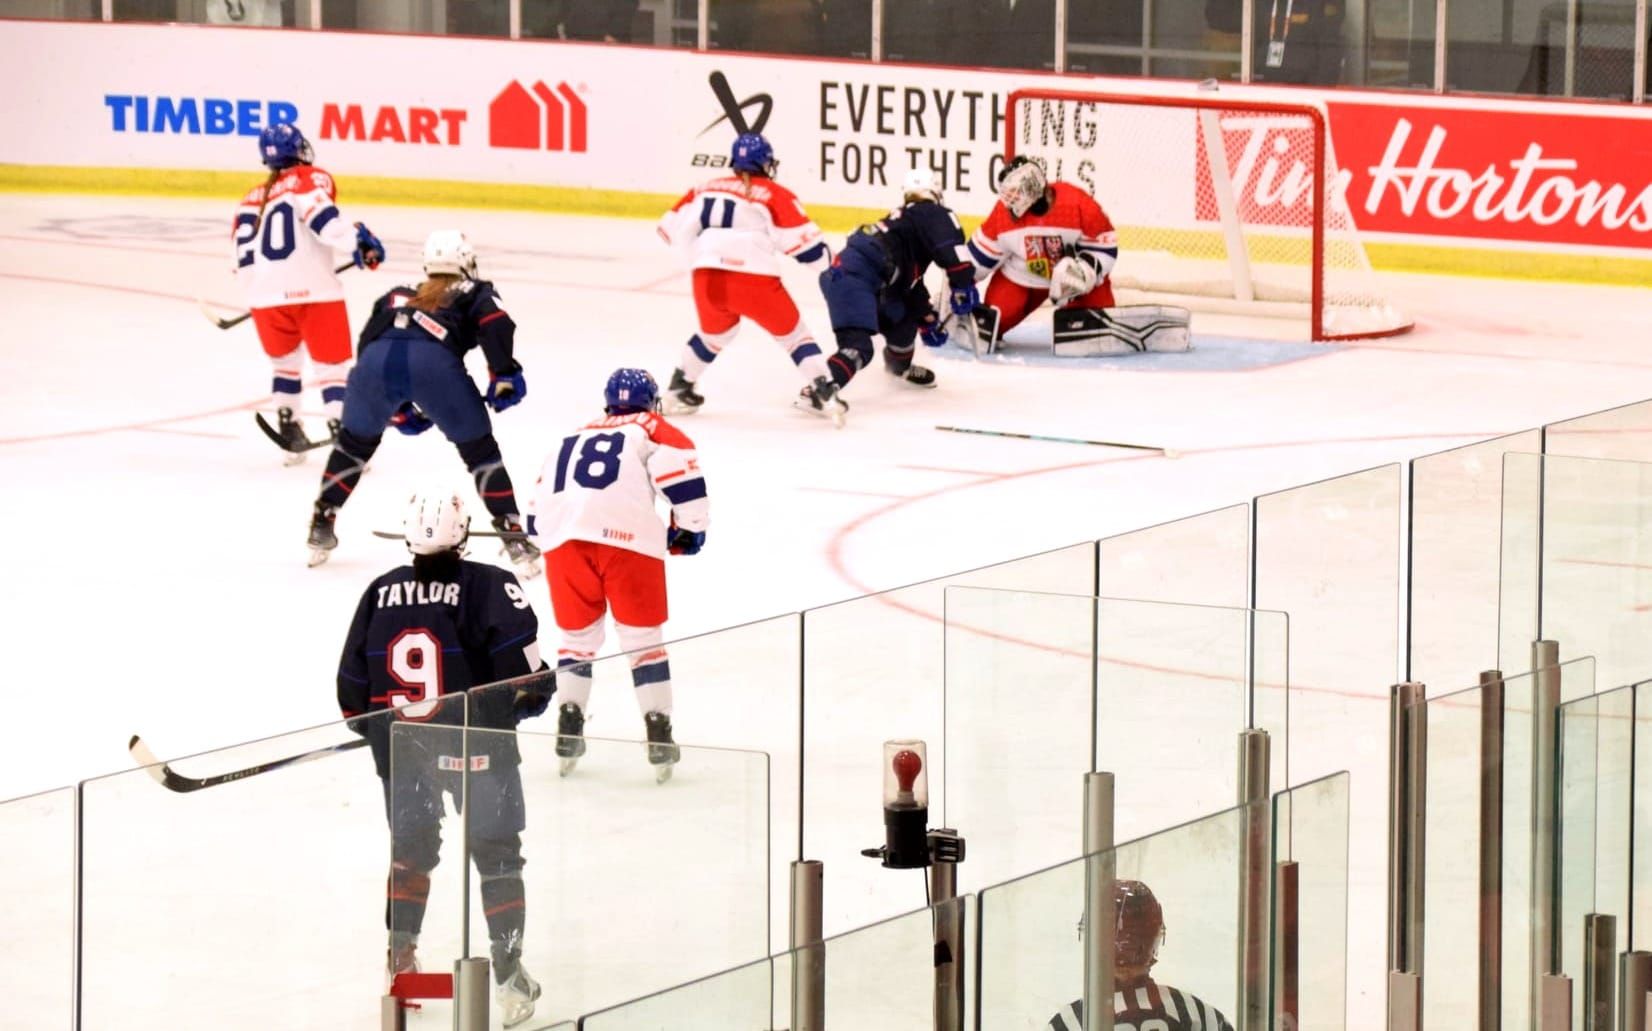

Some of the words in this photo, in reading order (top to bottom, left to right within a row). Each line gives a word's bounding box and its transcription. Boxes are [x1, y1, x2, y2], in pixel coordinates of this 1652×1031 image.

[105, 95, 299, 137] TIMBER
[319, 103, 467, 146] MART
[820, 82, 1098, 150] EVERYTHING
[820, 141, 888, 187] FOR
[905, 147, 971, 192] THE
[1364, 117, 1652, 231] Hortons
[236, 201, 296, 268] 20
[553, 431, 626, 494] 18
[425, 527, 434, 539] 9
[377, 580, 461, 609] TAYLOR
[503, 582, 529, 610] 9
[387, 627, 443, 723] 9
